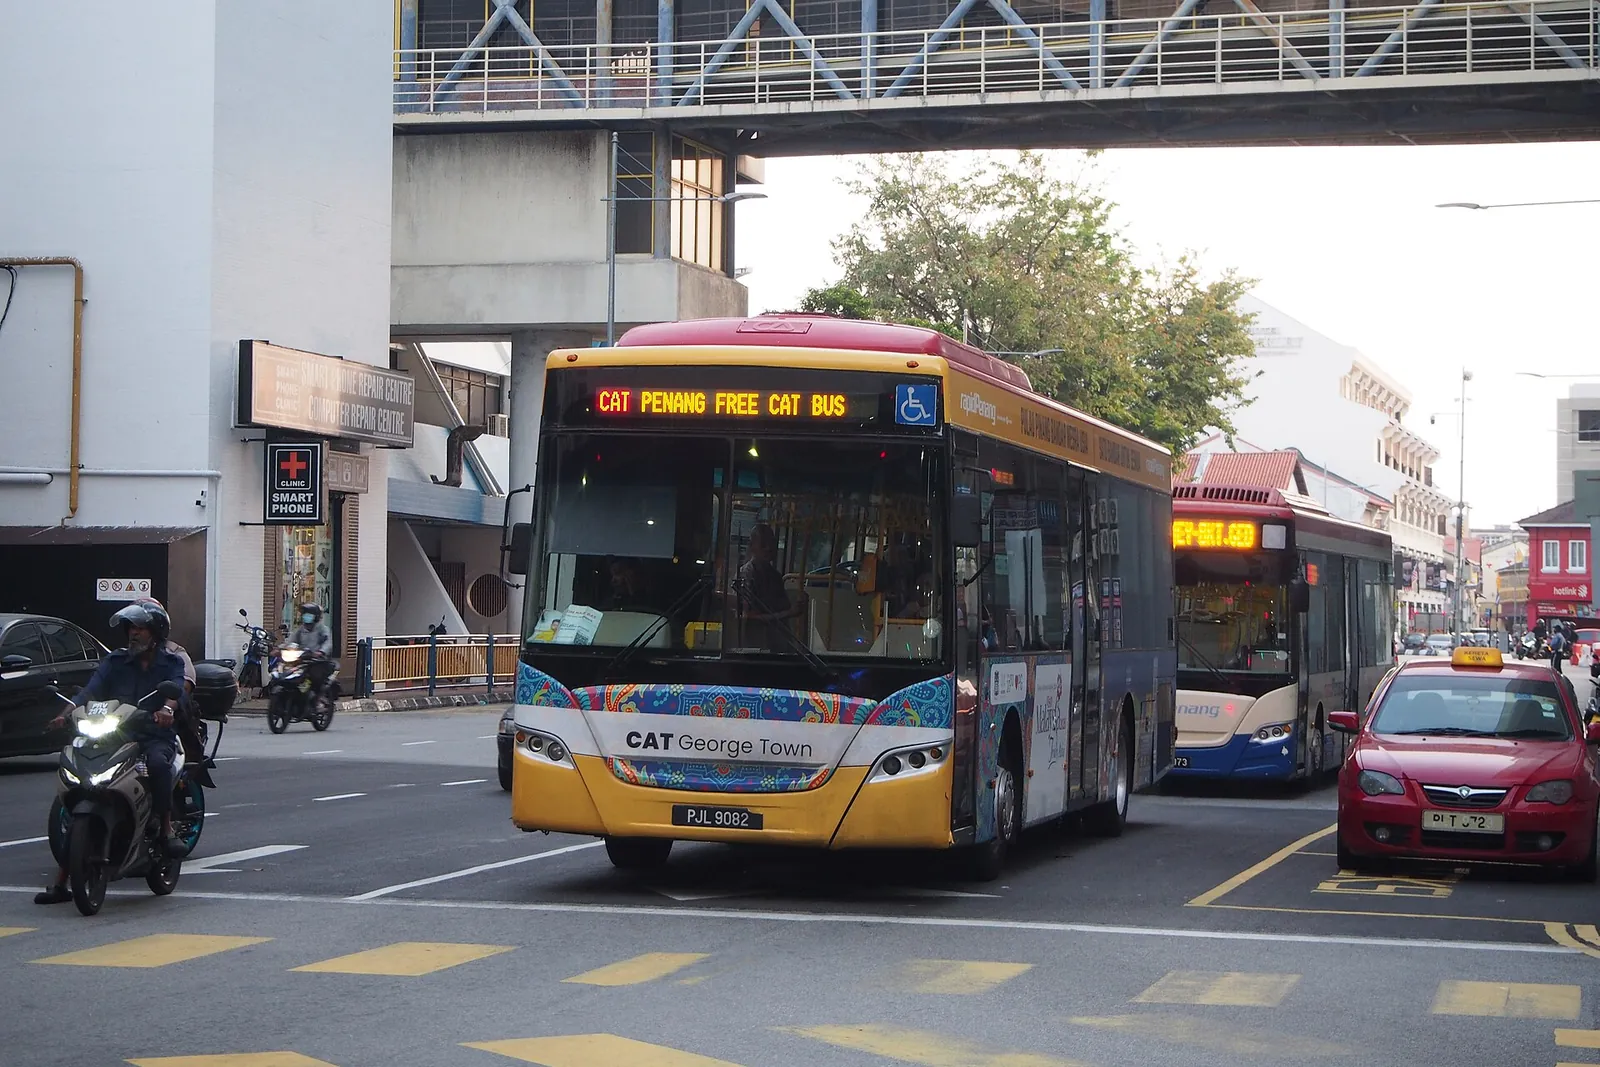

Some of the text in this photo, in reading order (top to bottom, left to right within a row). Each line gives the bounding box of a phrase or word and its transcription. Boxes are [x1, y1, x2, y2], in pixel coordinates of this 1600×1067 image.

[301, 360, 413, 405] SMART PHONE REPAIR CENTRE
[599, 391, 846, 417] CAT PENANG FREE CAT BUS
[308, 395, 405, 435] COMPUTER REPAIR CENTRE
[272, 492, 314, 503] SMART
[272, 504, 314, 514] PHONE
[1553, 586, 1577, 596] hotlink
[1175, 704, 1220, 718] nang
[626, 731, 812, 758] CAT George Town
[1174, 757, 1188, 767] 73
[687, 809, 749, 827] PJL 9082
